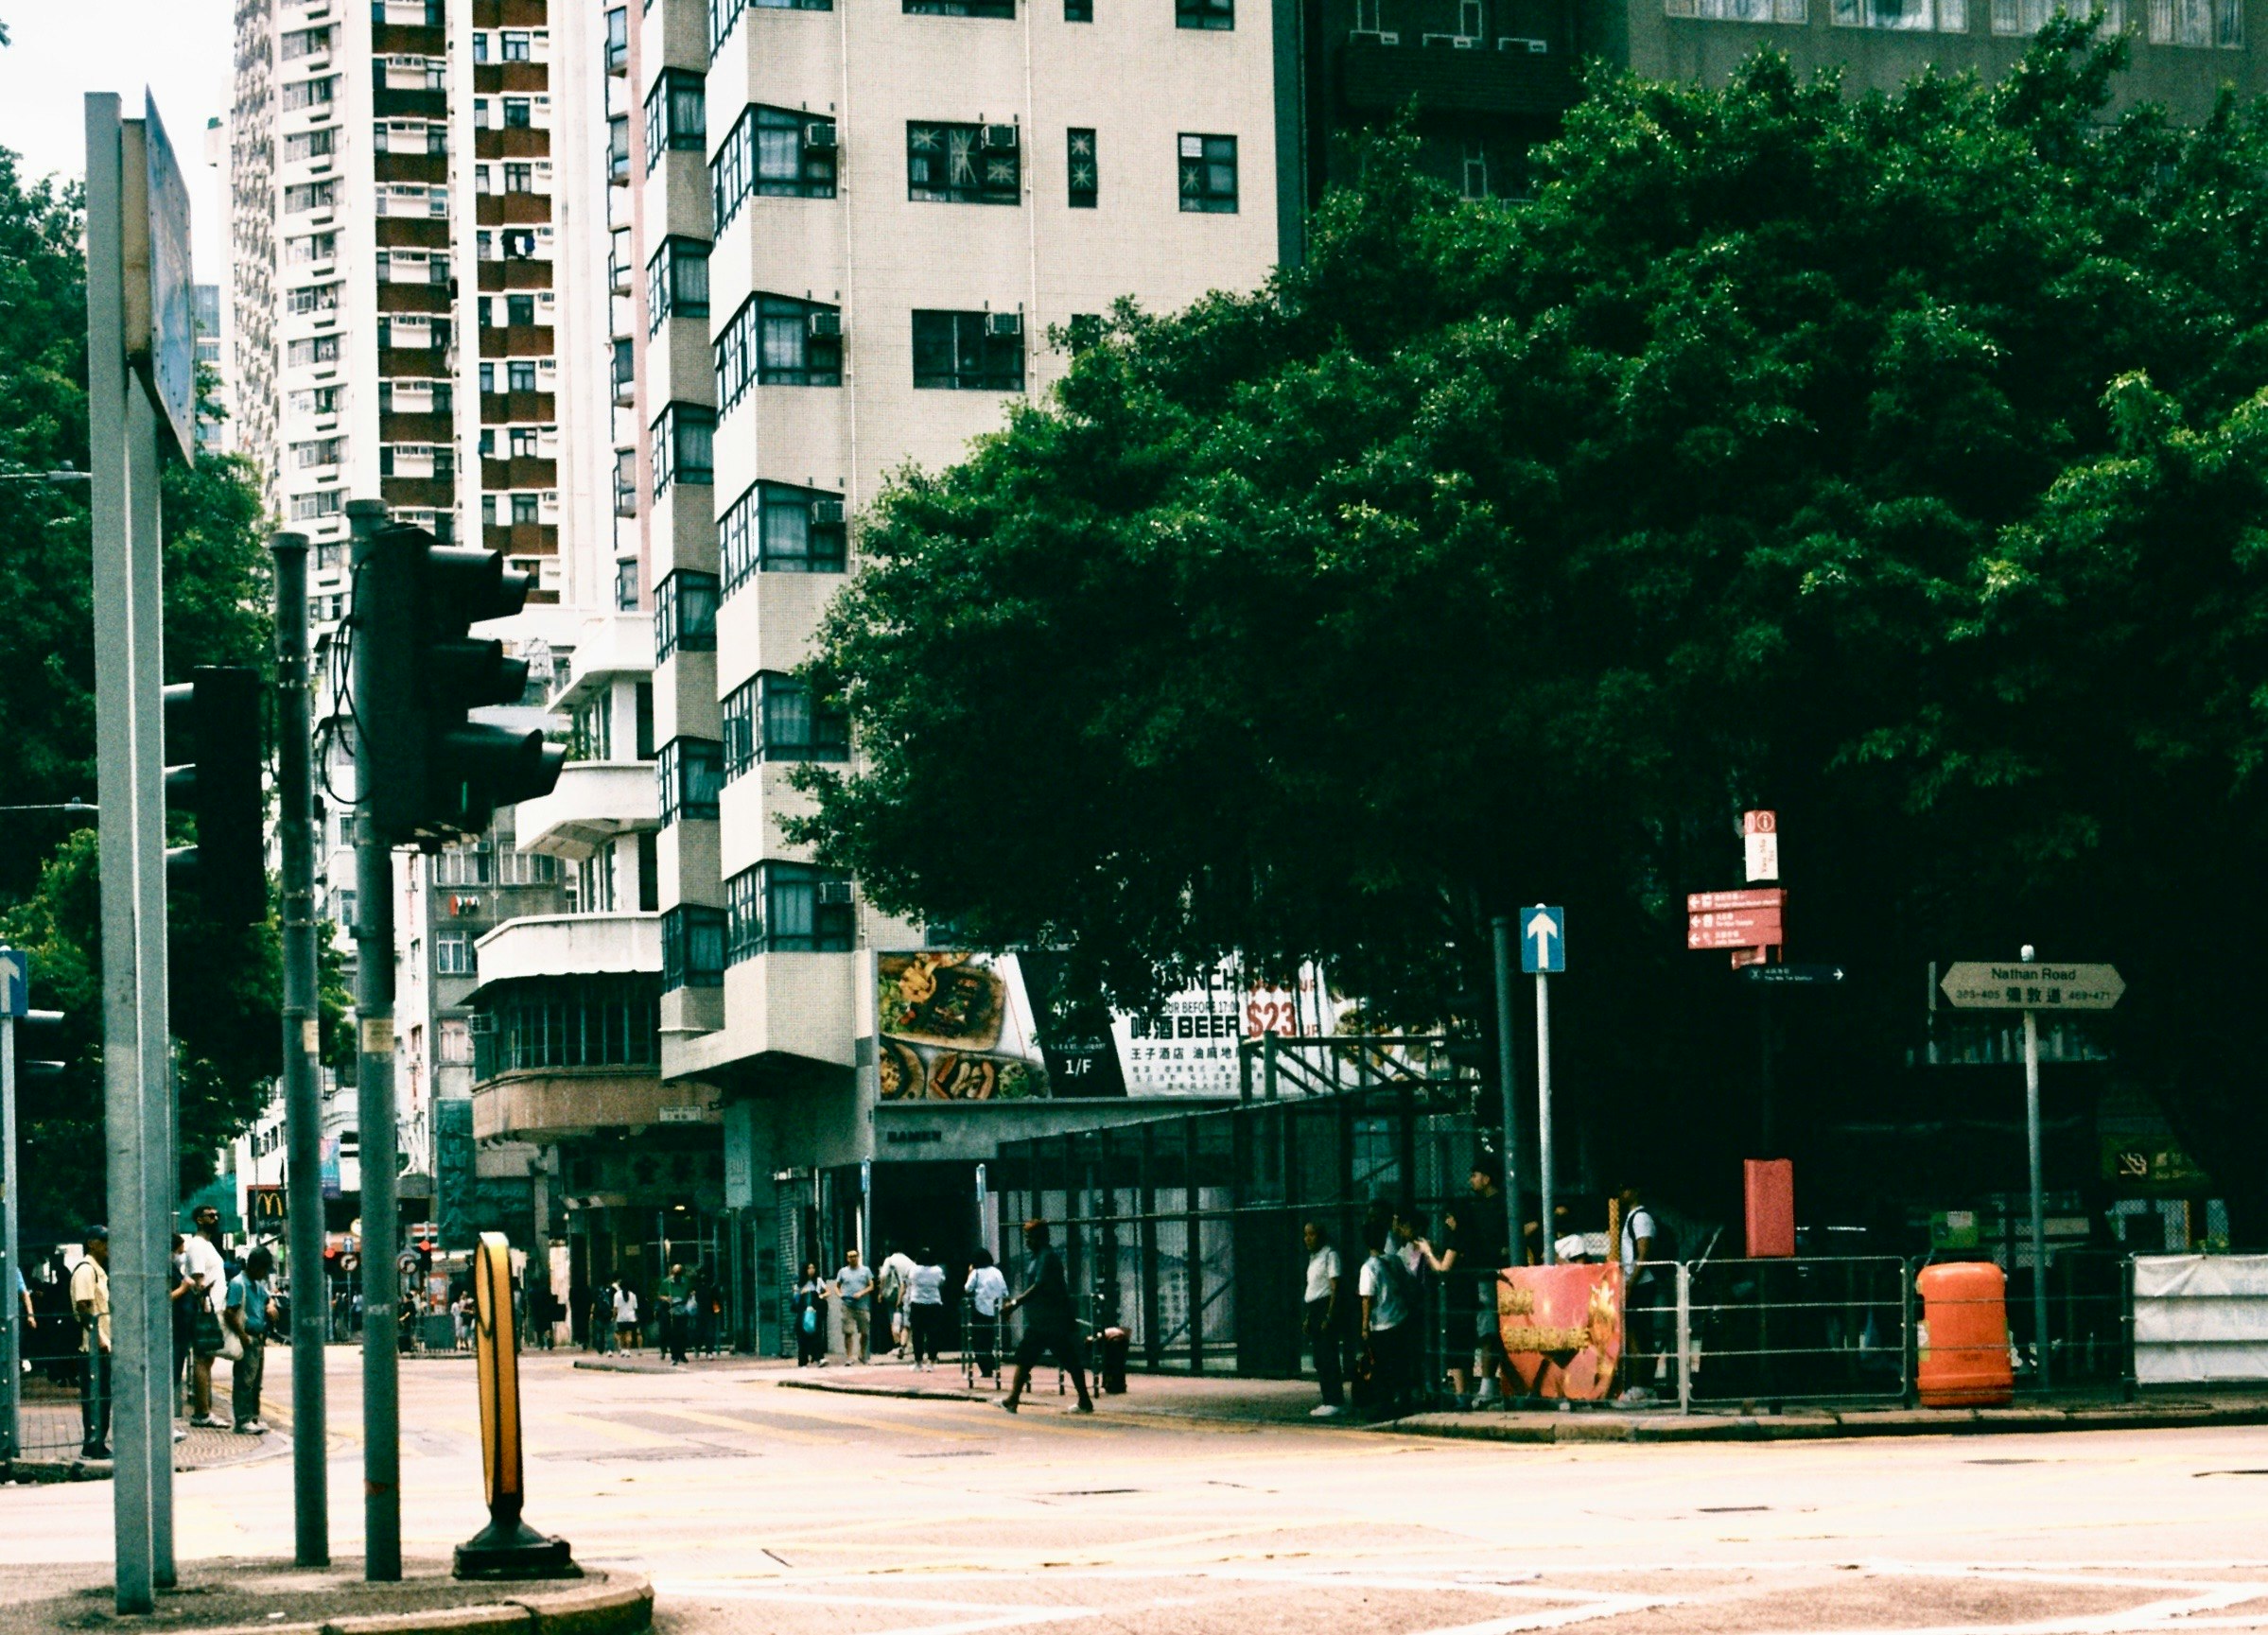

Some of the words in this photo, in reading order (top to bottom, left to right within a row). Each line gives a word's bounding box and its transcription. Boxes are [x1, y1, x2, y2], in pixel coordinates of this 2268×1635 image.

[1173, 968, 1239, 991] UNCH
[1991, 967, 2038, 981] Nathan
[2041, 967, 2077, 981] Road
[2006, 986, 2062, 1003] 彌敦道
[1178, 1015, 1241, 1039] BEER
[1247, 1000, 1297, 1037] $23
[1130, 1047, 1184, 1060] 王子酒店
[1193, 1047, 1239, 1060] 油麻地
[1064, 1057, 1092, 1077] 1/F
